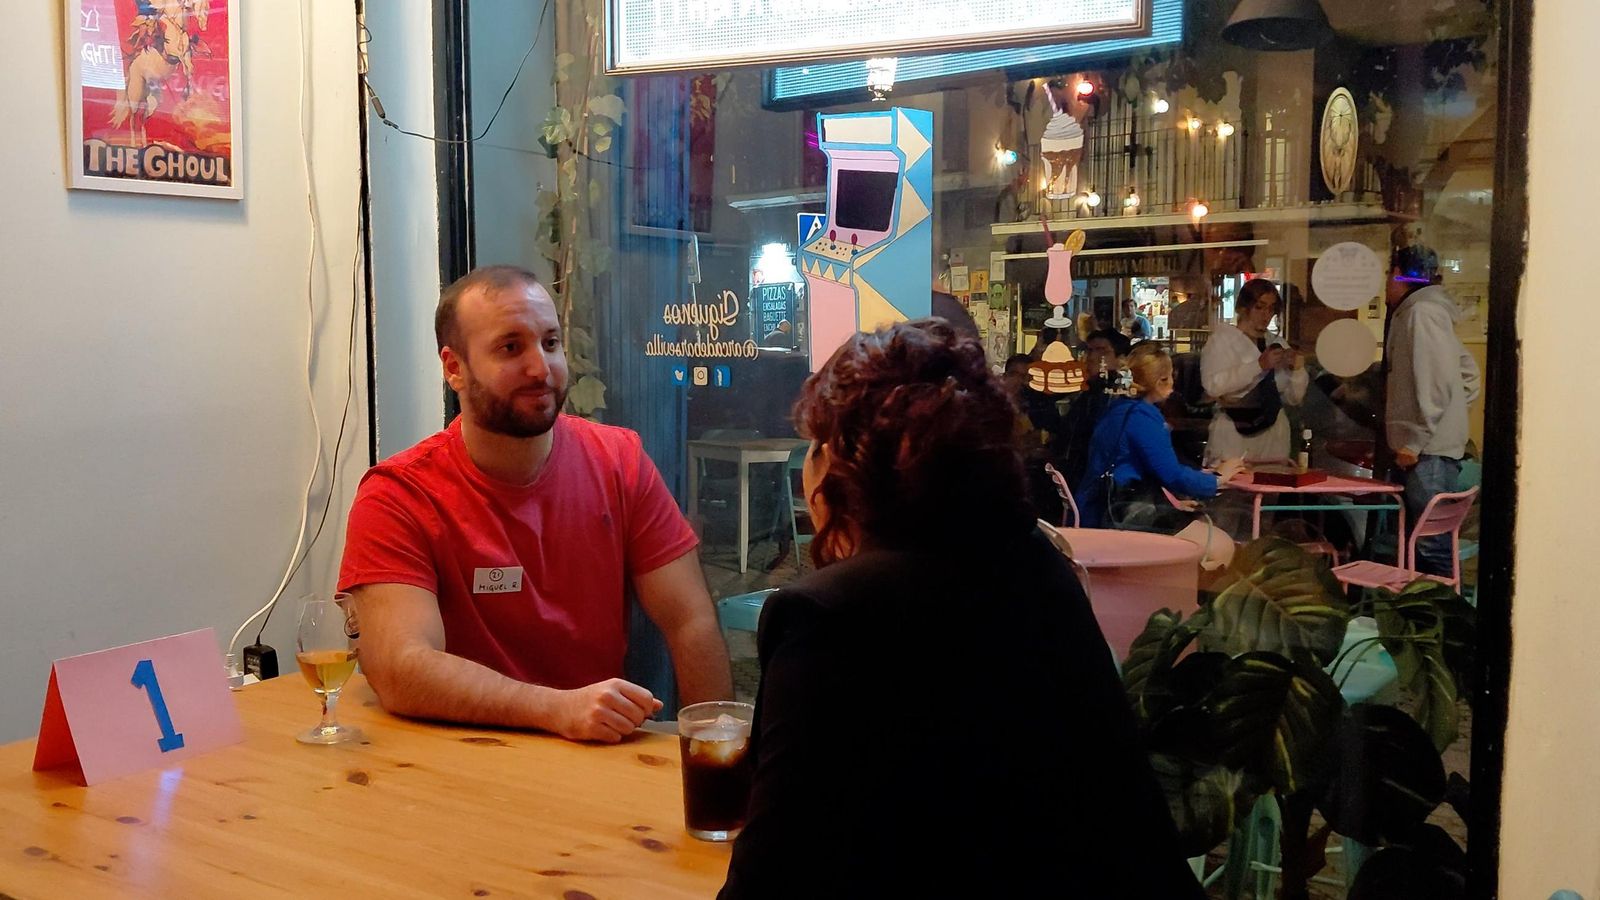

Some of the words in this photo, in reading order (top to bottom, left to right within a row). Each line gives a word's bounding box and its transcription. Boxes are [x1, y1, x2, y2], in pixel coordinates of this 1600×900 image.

[84, 139, 139, 175] THE
[143, 145, 228, 182] GHOUL
[762, 286, 787, 301] PIZZAS
[762, 301, 787, 311] ENSALADAS
[763, 311, 787, 322] BAGUETTE
[479, 584, 507, 592] MIGUEL
[130, 659, 185, 753] 1
